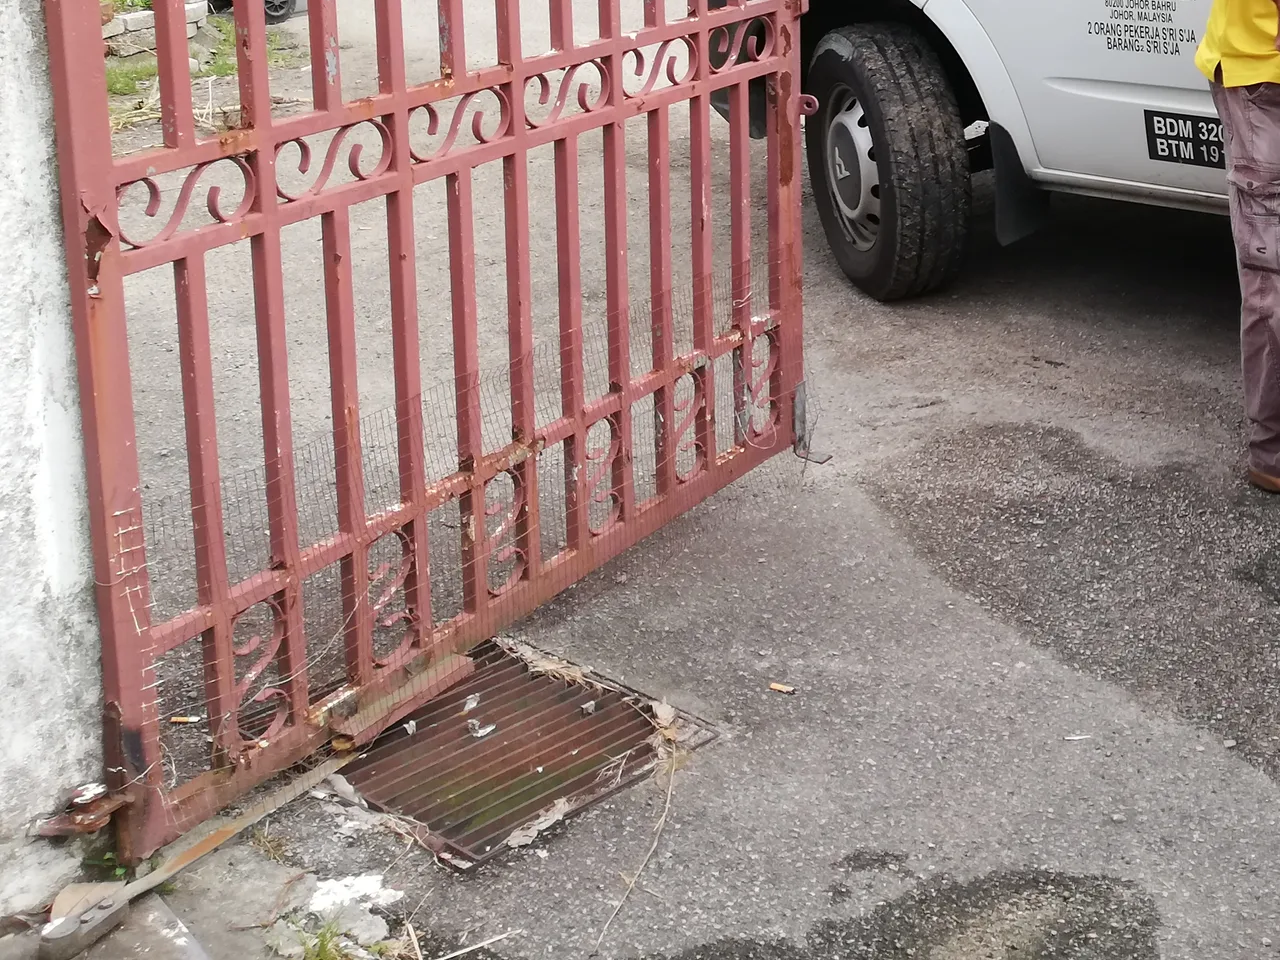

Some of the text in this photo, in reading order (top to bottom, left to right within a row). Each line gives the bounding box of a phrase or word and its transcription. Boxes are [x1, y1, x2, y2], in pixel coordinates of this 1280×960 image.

[1151, 0, 1176, 11] BAHRU
[1137, 11, 1173, 23] MALAYSIA
[1087, 21, 1092, 34] 2
[1094, 22, 1122, 37] ORANG
[1123, 24, 1160, 40] PEKERJA
[1153, 116, 1193, 138] BDM
[1156, 138, 1225, 163] BTM 19
